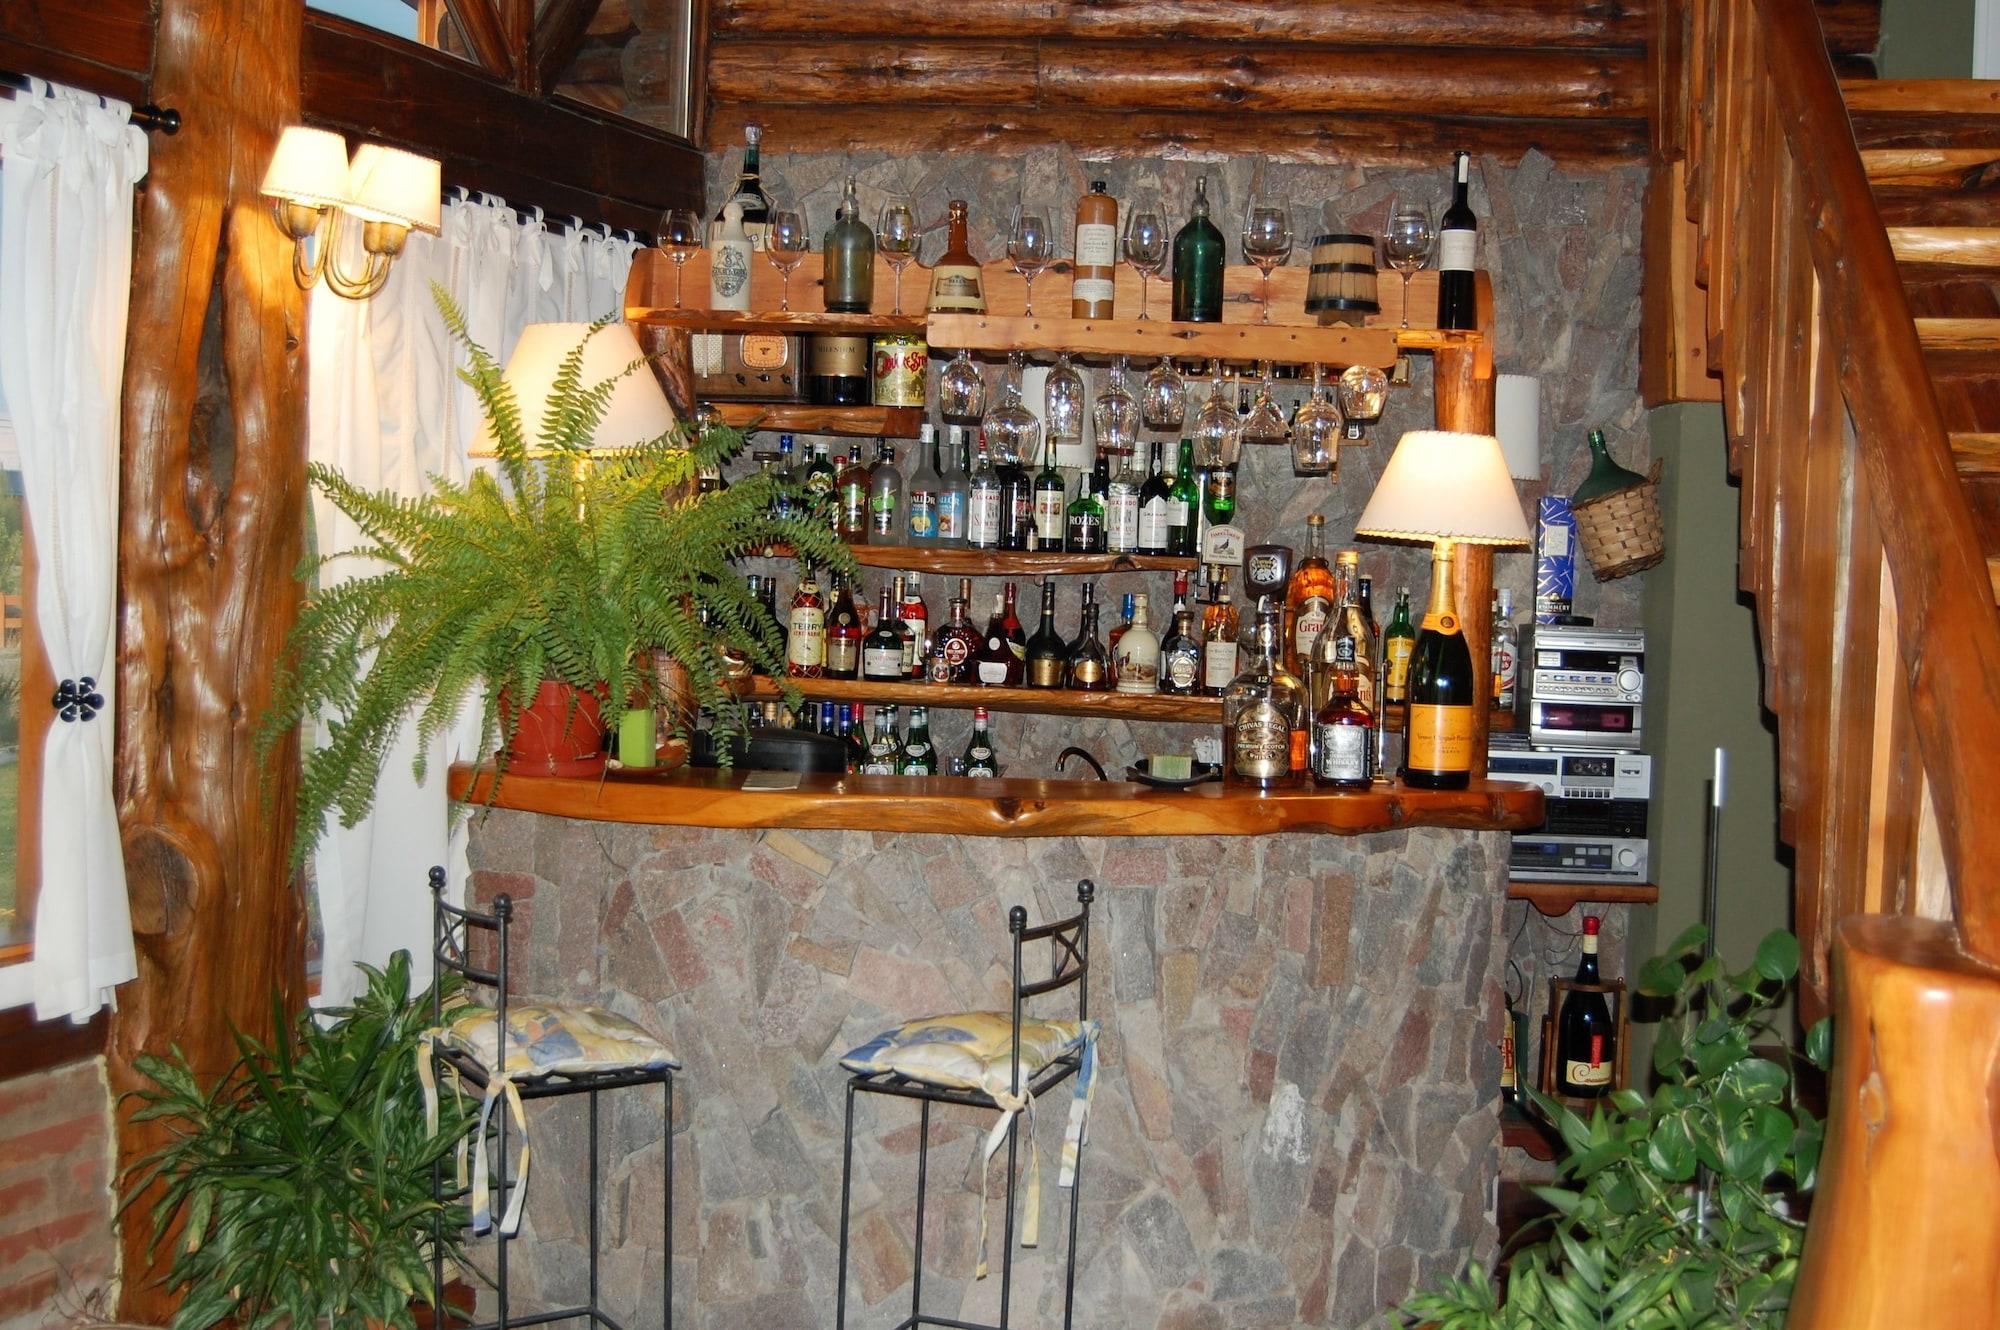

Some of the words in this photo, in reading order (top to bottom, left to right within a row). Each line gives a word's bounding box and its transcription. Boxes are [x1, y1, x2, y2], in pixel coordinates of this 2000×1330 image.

[1069, 513, 1101, 526] ROZÈS
[793, 622, 823, 631] TERRY
[1258, 675, 1269, 684] 12
[1238, 721, 1263, 732] CHIVAS
